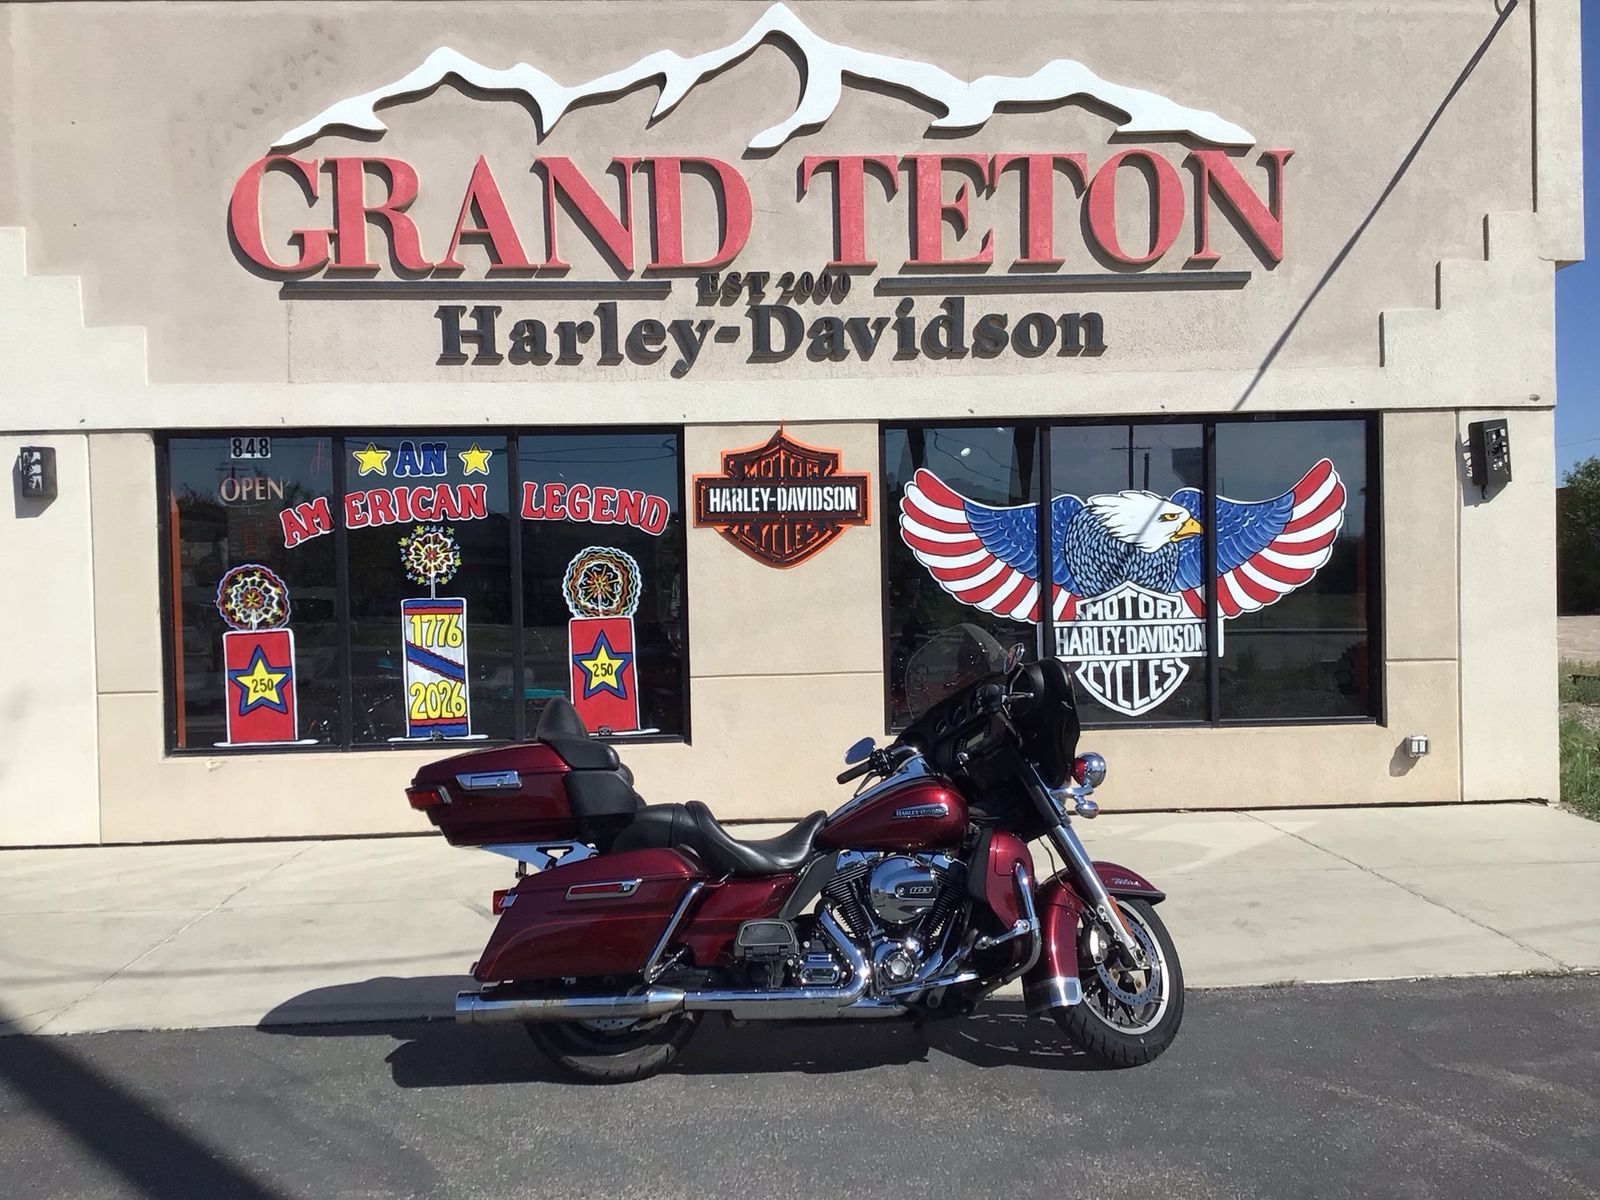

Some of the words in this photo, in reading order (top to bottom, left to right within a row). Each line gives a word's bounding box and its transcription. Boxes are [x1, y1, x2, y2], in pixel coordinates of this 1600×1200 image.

[229, 153, 753, 275] GRAND
[802, 148, 1296, 267] TETON
[697, 271, 770, 304] EST
[776, 271, 852, 304] 2000
[436, 297, 1107, 378] Harley-Davidson
[232, 438, 270, 458] 848
[393, 440, 448, 477] AN
[220, 476, 285, 502] OPEN
[708, 486, 858, 513] HARLEY-DAVIDSON
[521, 481, 670, 536] LEGEND
[1086, 588, 1173, 621] MOTOR
[409, 613, 463, 648] 1776
[1054, 623, 1207, 656] HARLEY-DAVIDSON
[251, 677, 275, 694] 250
[592, 663, 614, 678] 250
[1087, 658, 1178, 709] CYCLES
[409, 681, 467, 720] 2026
